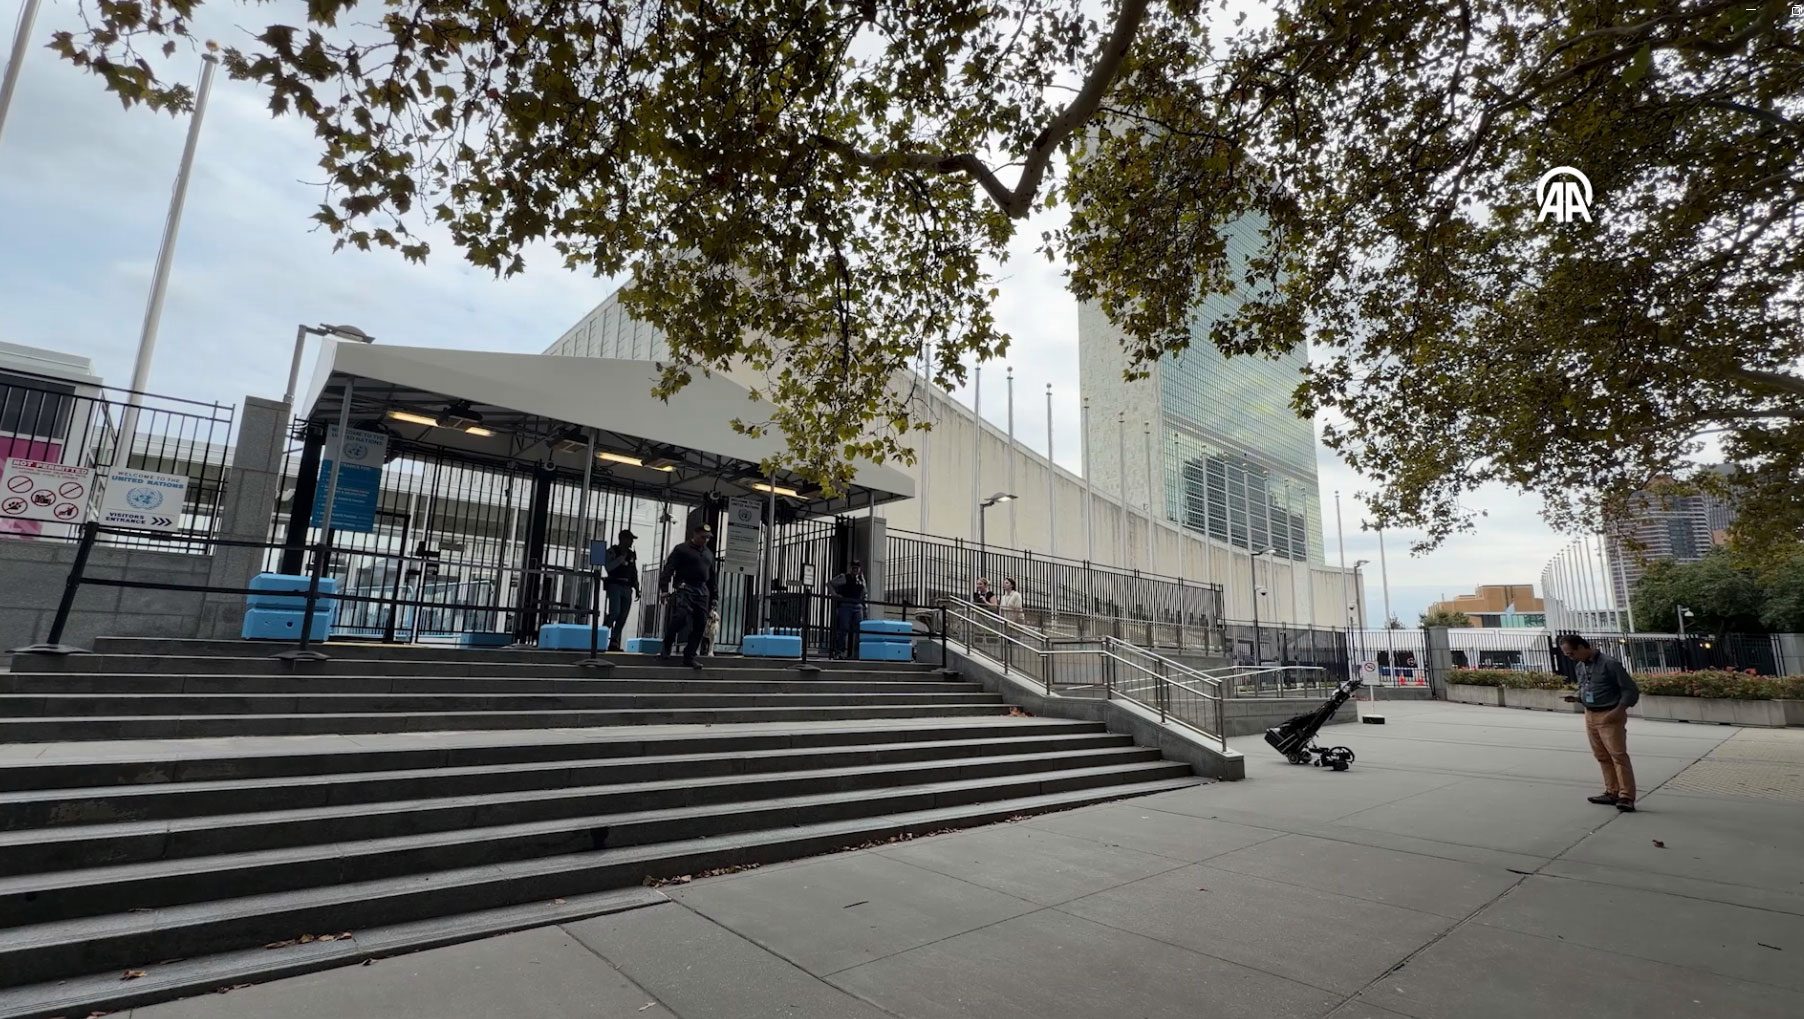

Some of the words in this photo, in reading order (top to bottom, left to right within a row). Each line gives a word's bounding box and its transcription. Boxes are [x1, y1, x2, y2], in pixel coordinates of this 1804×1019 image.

[118, 471, 153, 479] WELCOME
[112, 475, 143, 484] UNITED
[147, 480, 184, 489] NATIONS
[106, 516, 145, 524] ENTRANCE
